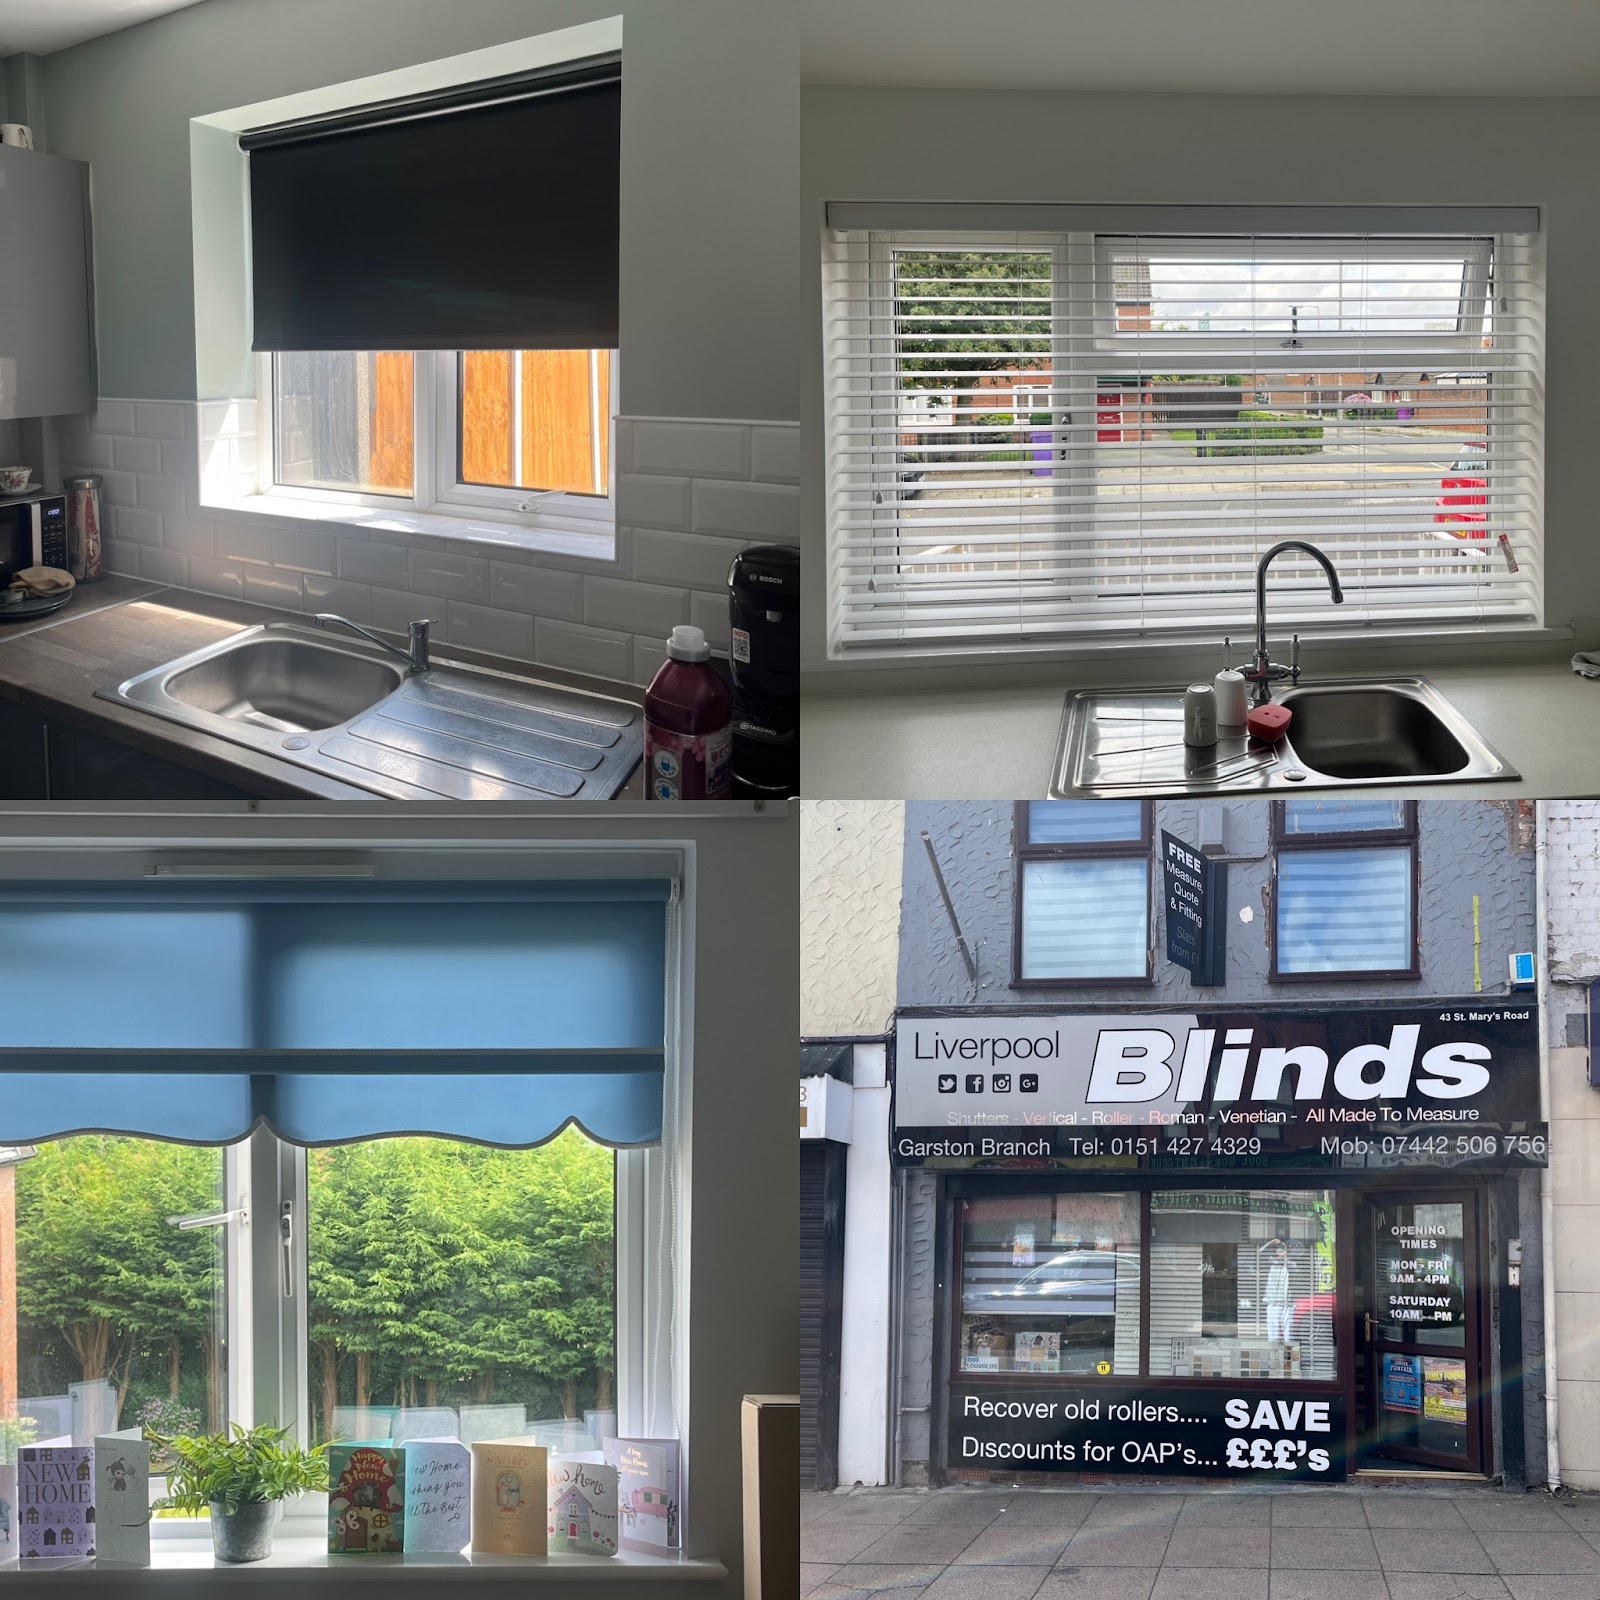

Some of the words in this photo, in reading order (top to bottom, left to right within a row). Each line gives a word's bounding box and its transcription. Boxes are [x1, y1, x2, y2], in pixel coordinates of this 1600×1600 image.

[760, 576, 782, 584] BOSCH
[749, 724, 776, 736] TASSIMO
[1168, 842, 1202, 874] FREE
[1166, 860, 1204, 894] Measure,
[1174, 882, 1198, 906] Quote
[1170, 897, 1178, 910] &
[1179, 901, 1202, 928] Fitting
[1176, 926, 1196, 946] Slats
[1172, 941, 1189, 960] from
[1439, 1013, 1451, 1021] 43
[1454, 1012, 1466, 1021] St.
[1469, 1012, 1500, 1022] Mary's
[1504, 1011, 1529, 1020] Road
[915, 1031, 1059, 1066] Liverpool
[1085, 1024, 1492, 1104] Blinds
[948, 1111, 1009, 1125] Shutters
[1023, 1111, 1076, 1124] Vertical
[1092, 1110, 1134, 1124] Roller
[1150, 1110, 1204, 1124] Roman
[1219, 1110, 1286, 1124] Venetian
[1306, 1108, 1326, 1122] All
[1330, 1108, 1376, 1122] Made
[1380, 1107, 1402, 1122] To
[1406, 1106, 1480, 1122] Measure
[898, 1138, 974, 1156] Garston
[982, 1138, 1050, 1156] Branch
[1069, 1138, 1104, 1155] Tel:
[1111, 1138, 1162, 1155] 0151
[1167, 1138, 1203, 1155] 427
[1211, 1138, 1261, 1155] 4329
[1321, 1136, 1374, 1155] Mob:
[1382, 1136, 1448, 1154] 07442
[1456, 1136, 1496, 1154] 506
[1505, 1136, 1545, 1154] 756
[1391, 1226, 1446, 1236] OPENING
[1400, 1240, 1437, 1249] TIMES
[1391, 1260, 1417, 1270] MON
[1428, 1260, 1448, 1270] FRI
[1390, 1274, 1414, 1283] 9AM
[1424, 1275, 1450, 1284] 4PM
[1390, 1296, 1451, 1307] SATURDAY
[1390, 1310, 1420, 1320] 10AM
[964, 1396, 1058, 1418] Recover
[1065, 1398, 1100, 1420] old
[1224, 1398, 1330, 1432] SAVE
[352, 1452, 384, 1464] Happy
[962, 1436, 1075, 1460] Discounts
[1083, 1440, 1115, 1462] for
[1226, 1438, 1330, 1472] £££'s
[24, 1463, 76, 1484] NEW
[356, 1460, 380, 1470] New
[430, 1460, 462, 1476] Home
[345, 1470, 388, 1483] Home
[570, 1464, 606, 1496] home
[25, 1484, 91, 1504] HOME
[444, 1481, 464, 1496] you
[420, 1502, 438, 1515] the
[440, 1496, 466, 1514] Best
